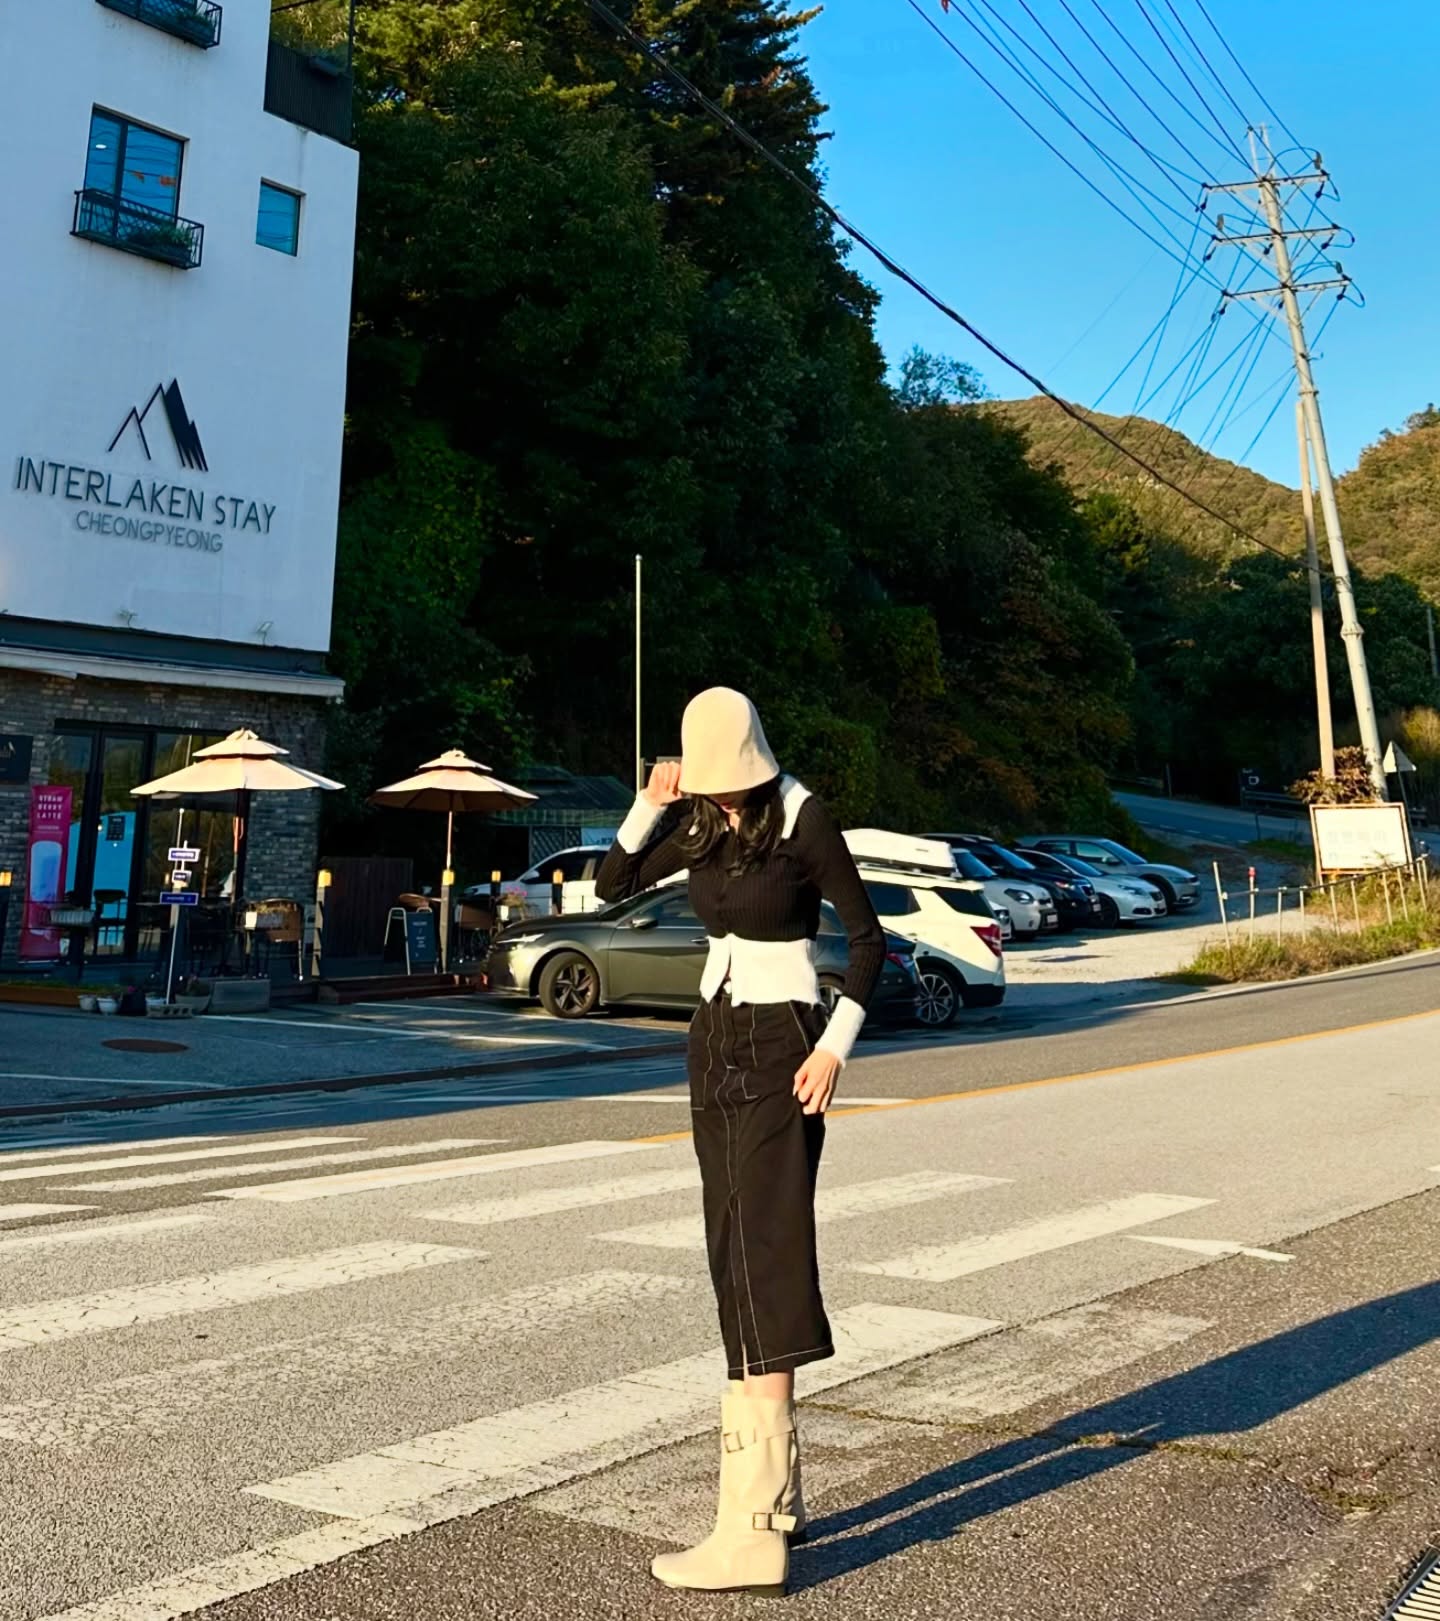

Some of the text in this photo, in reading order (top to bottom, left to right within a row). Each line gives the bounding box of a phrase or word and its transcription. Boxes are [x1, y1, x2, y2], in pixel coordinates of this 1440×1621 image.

[16, 456, 277, 534] INTERLAKEN STAY
[76, 510, 223, 553] CHEONGPYEONG
[37, 812, 61, 820] LATTE
